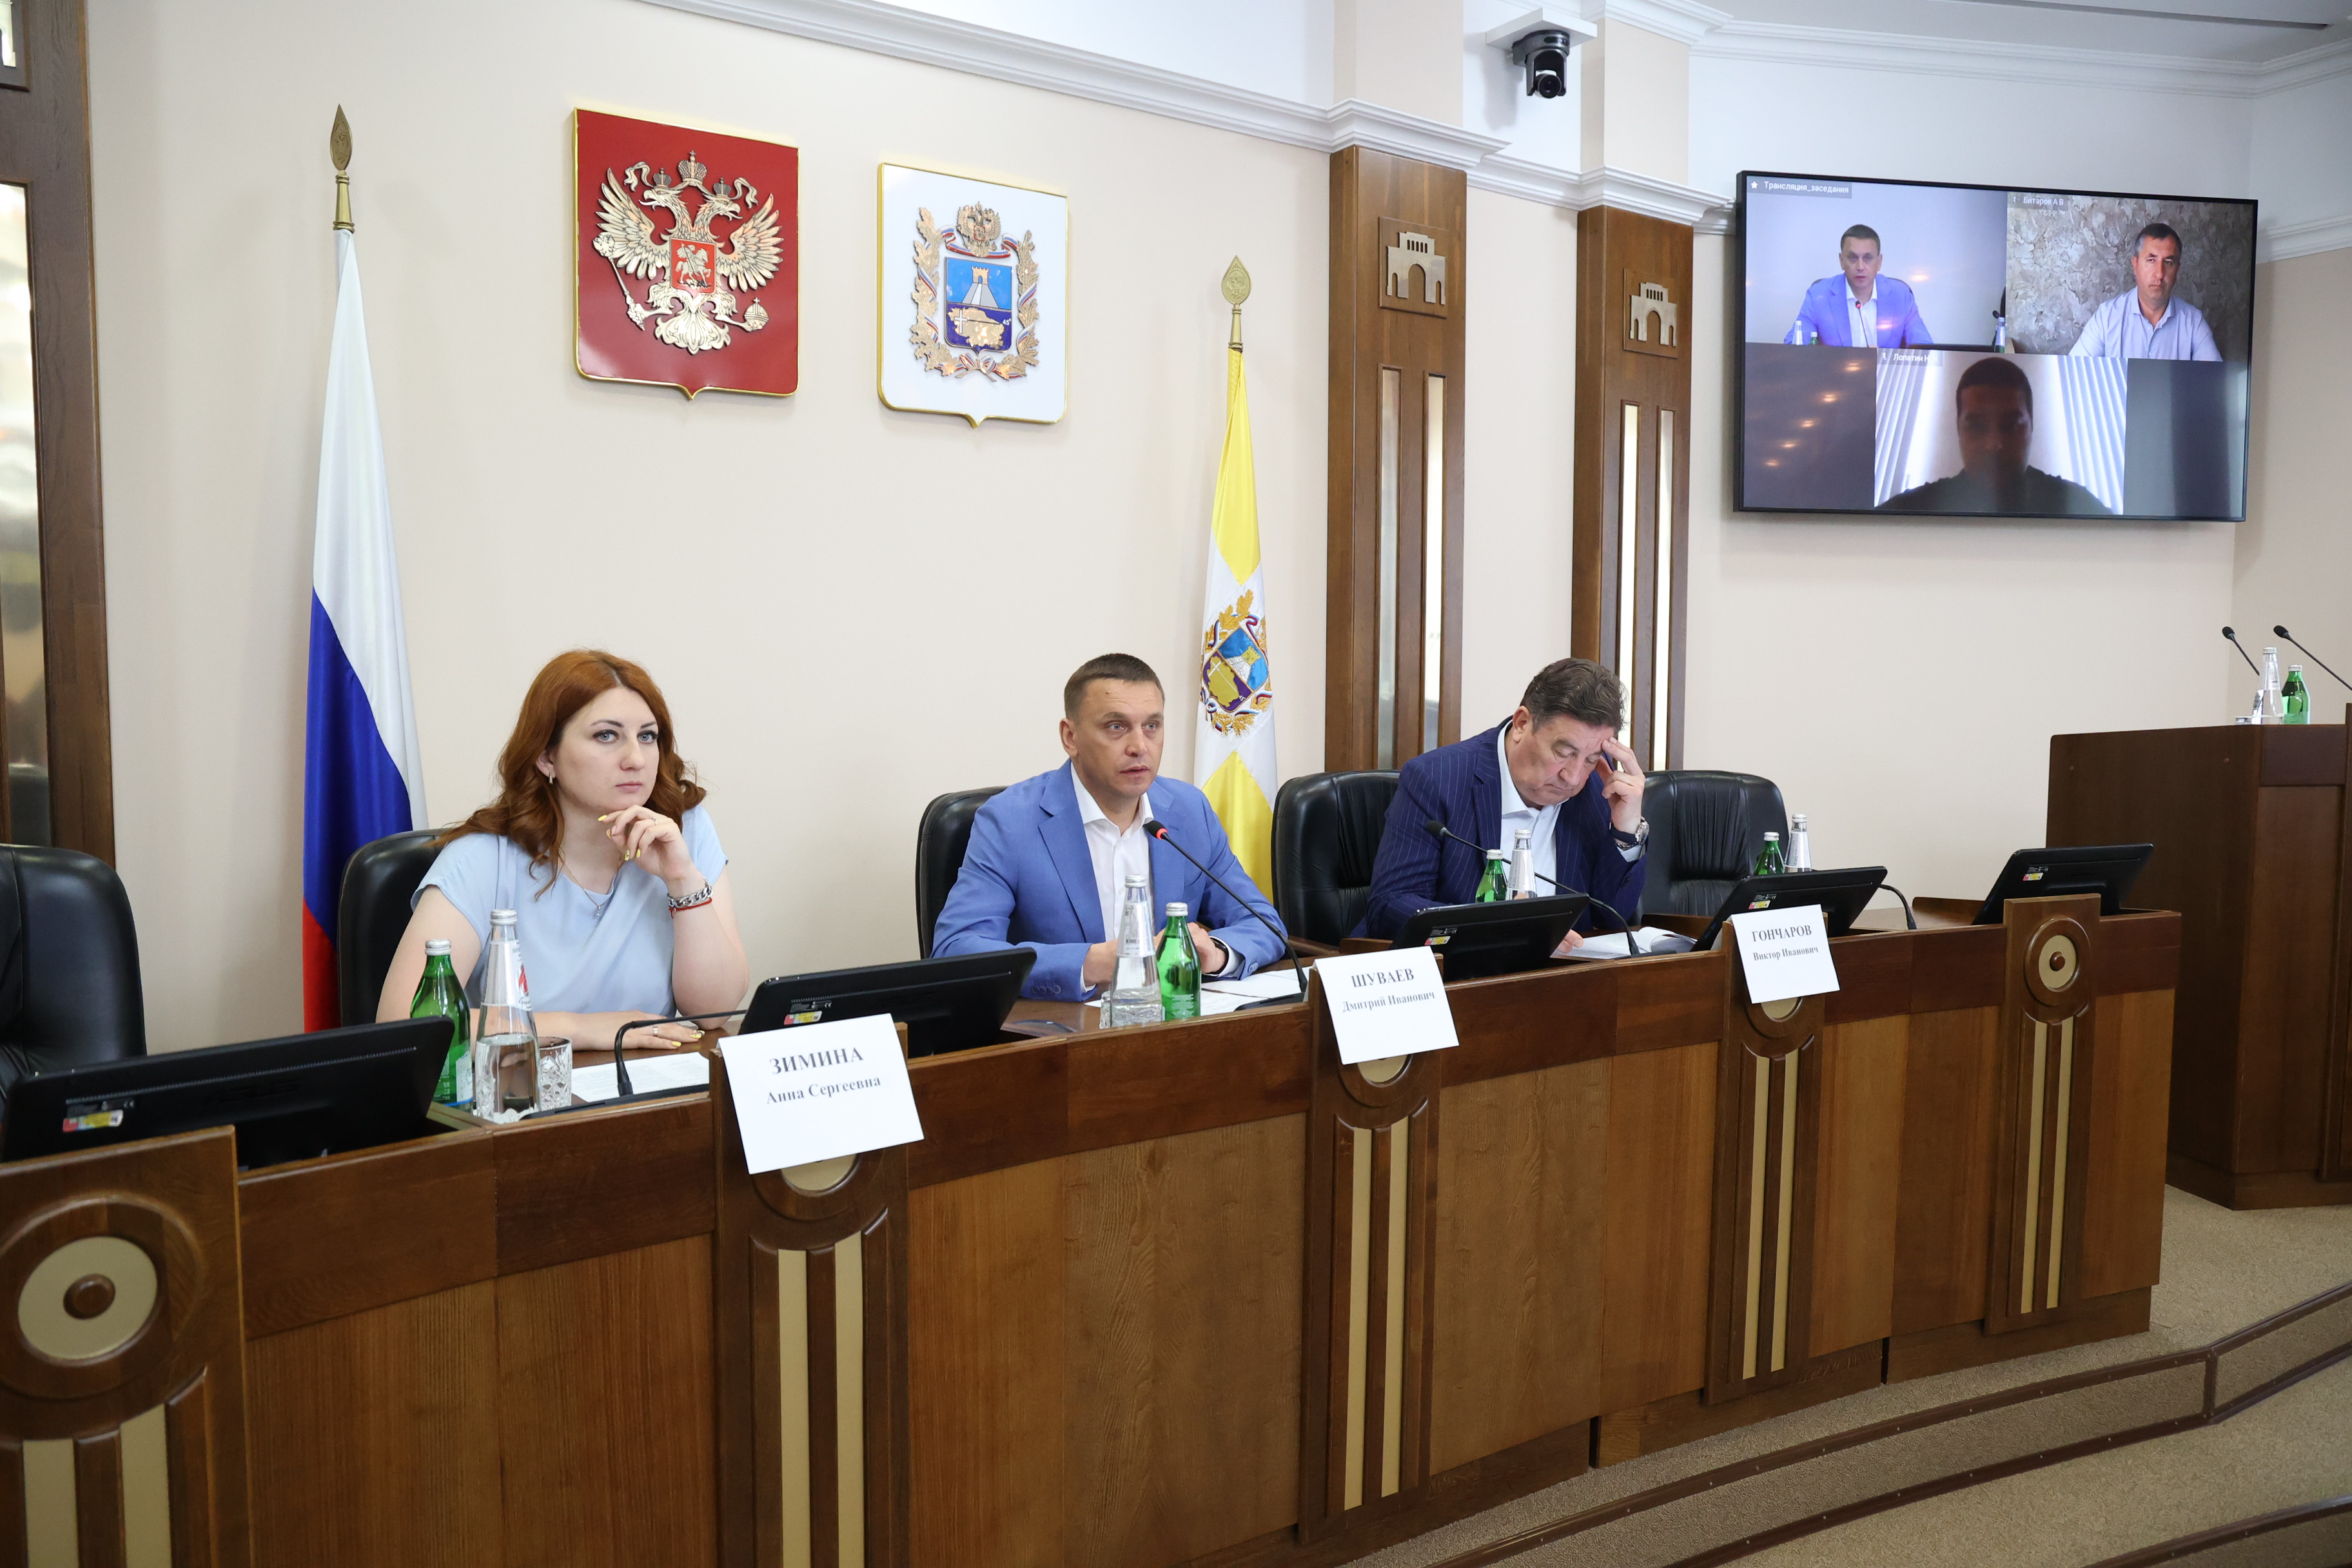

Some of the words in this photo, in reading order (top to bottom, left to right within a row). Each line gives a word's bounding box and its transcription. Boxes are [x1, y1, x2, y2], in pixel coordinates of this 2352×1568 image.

[1764, 181, 1849, 193] Трансляция_заседания
[2023, 197, 2052, 206] Битаров
[1893, 353, 1923, 362] Лопатин
[1752, 925, 1811, 941] ГОНЧАРОВ
[1753, 952, 1780, 961] Виктор
[1782, 947, 1818, 957] Иванович
[1351, 969, 1414, 987] ШУВАЕВ
[1344, 997, 1386, 1012] Дмитрий
[1388, 992, 1435, 1004] Иванович
[770, 1048, 863, 1074] ЗИМИНА
[767, 1089, 805, 1104] Анна
[808, 1078, 880, 1097] Сергеевна
